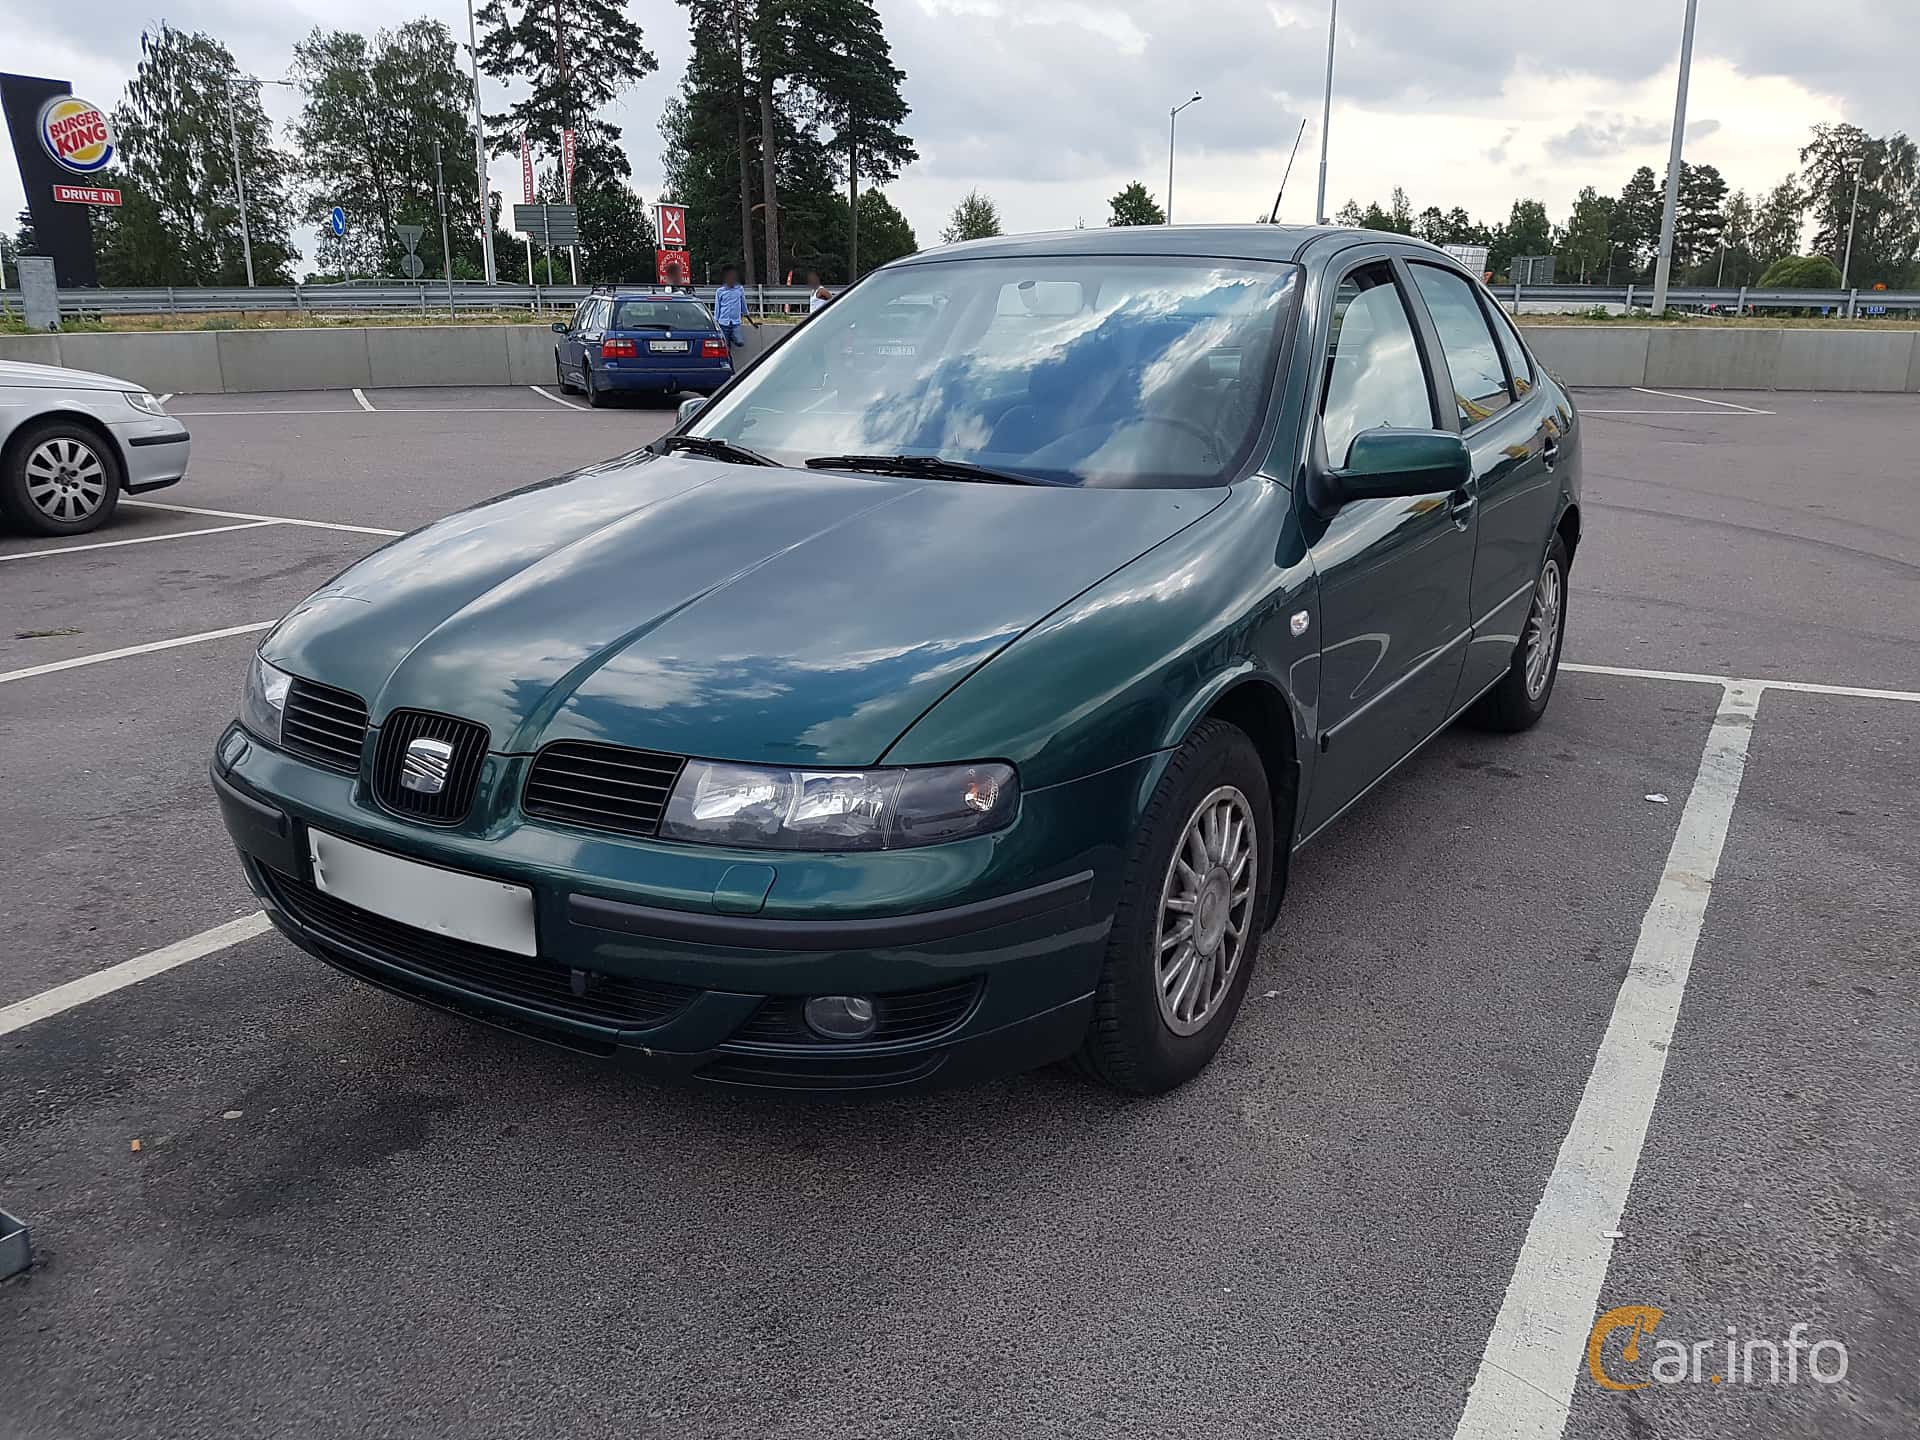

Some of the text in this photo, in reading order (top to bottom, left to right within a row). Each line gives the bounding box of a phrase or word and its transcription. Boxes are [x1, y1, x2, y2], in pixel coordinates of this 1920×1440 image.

[49, 111, 101, 138] BURGER
[56, 123, 107, 158] KING
[62, 189, 115, 202] DRIVE IN
